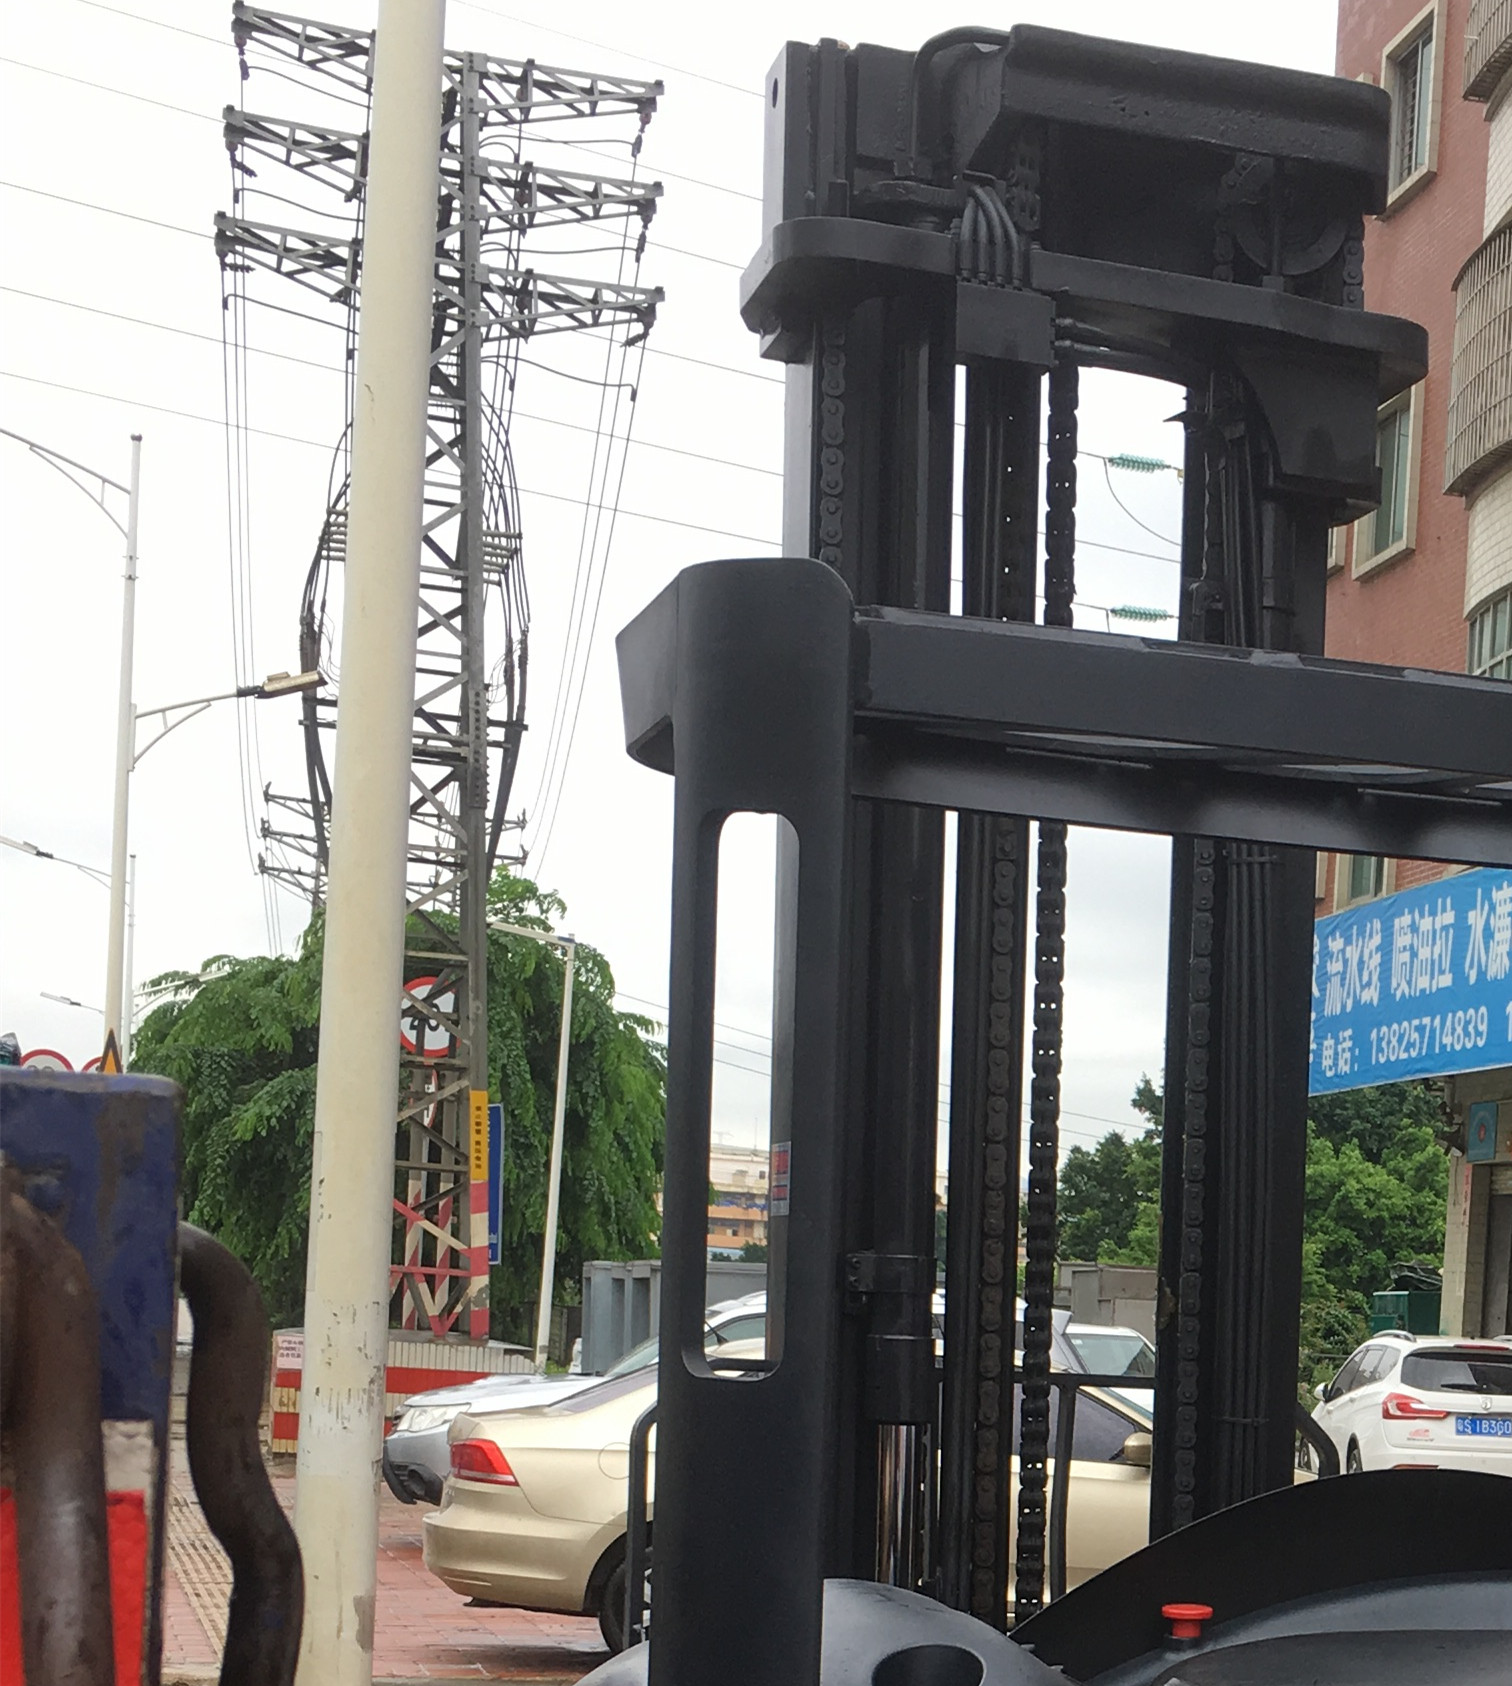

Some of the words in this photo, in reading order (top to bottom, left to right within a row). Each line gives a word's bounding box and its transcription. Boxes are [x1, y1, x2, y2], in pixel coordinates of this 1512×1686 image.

[1324, 918, 1382, 1018] 流水线
[1391, 896, 1455, 1002] 喷油拉
[1370, 1006, 1488, 1066] 13825714839
